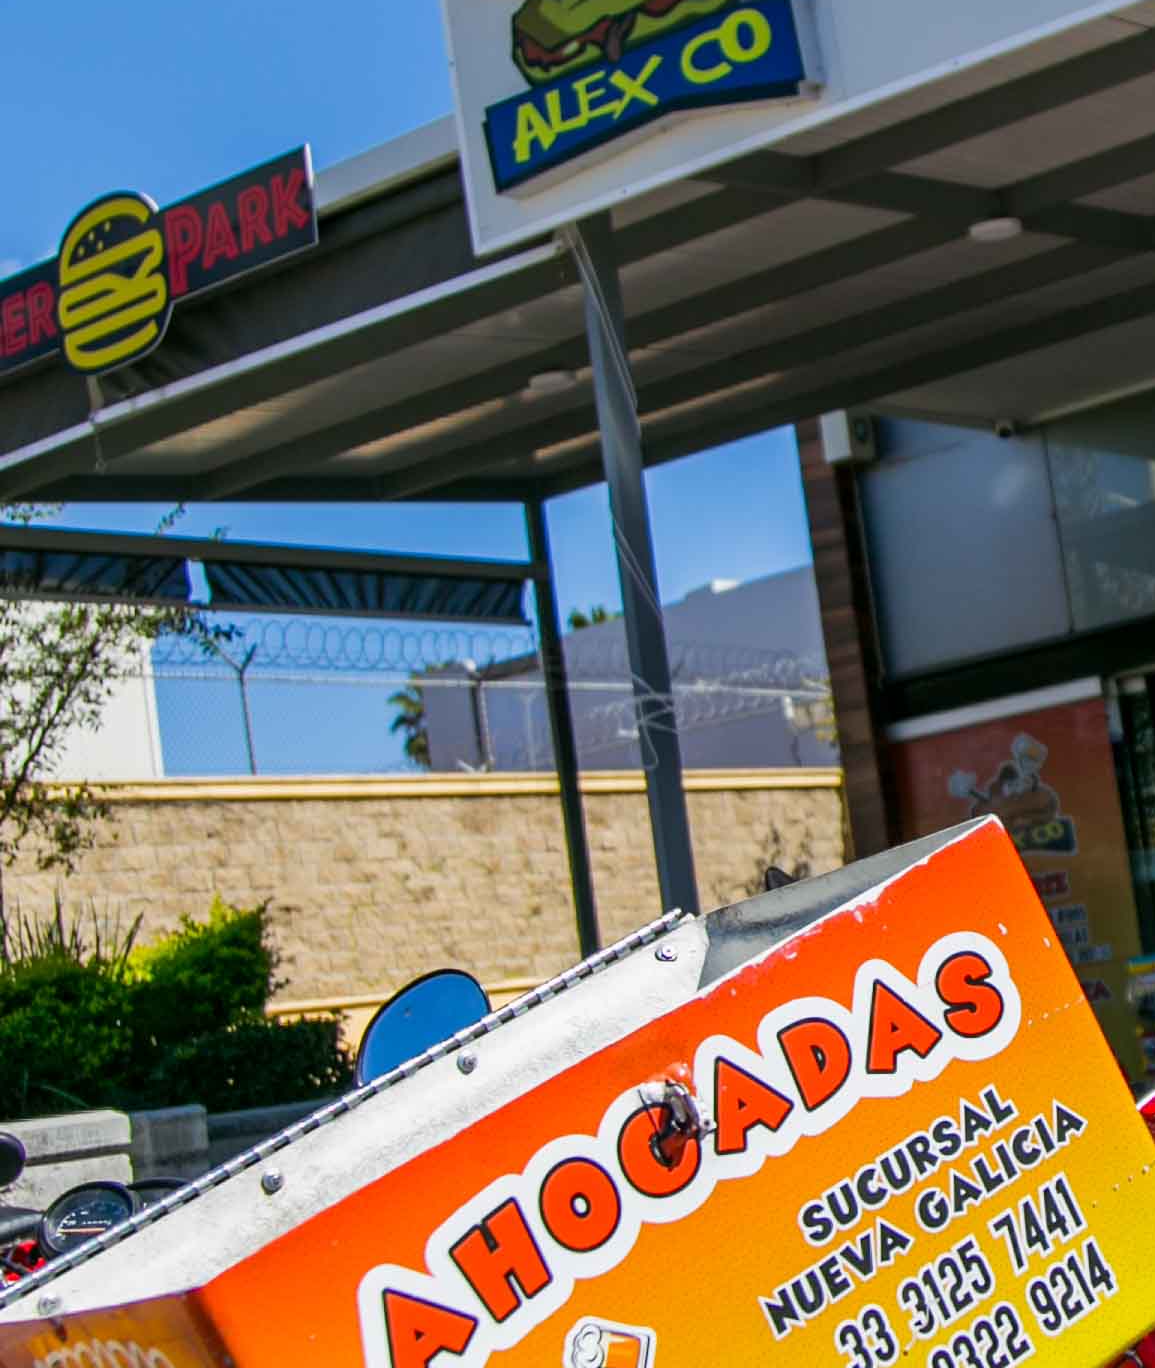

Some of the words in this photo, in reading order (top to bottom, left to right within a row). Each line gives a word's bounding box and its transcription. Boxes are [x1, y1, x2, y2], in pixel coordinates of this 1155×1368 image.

[512, 54, 660, 163] ALEX
[680, 7, 772, 85] CO
[163, 168, 310, 297] PARK
[0, 281, 58, 358] ER
[765, 1222, 911, 1335] NUEVA
[918, 1103, 1085, 1229] GALICIA
[802, 1089, 1014, 1242] SUCURSAL
[901, 1240, 992, 1335] 3125
[993, 1178, 1083, 1271] 7441
[1029, 1241, 1114, 1332] 9214
